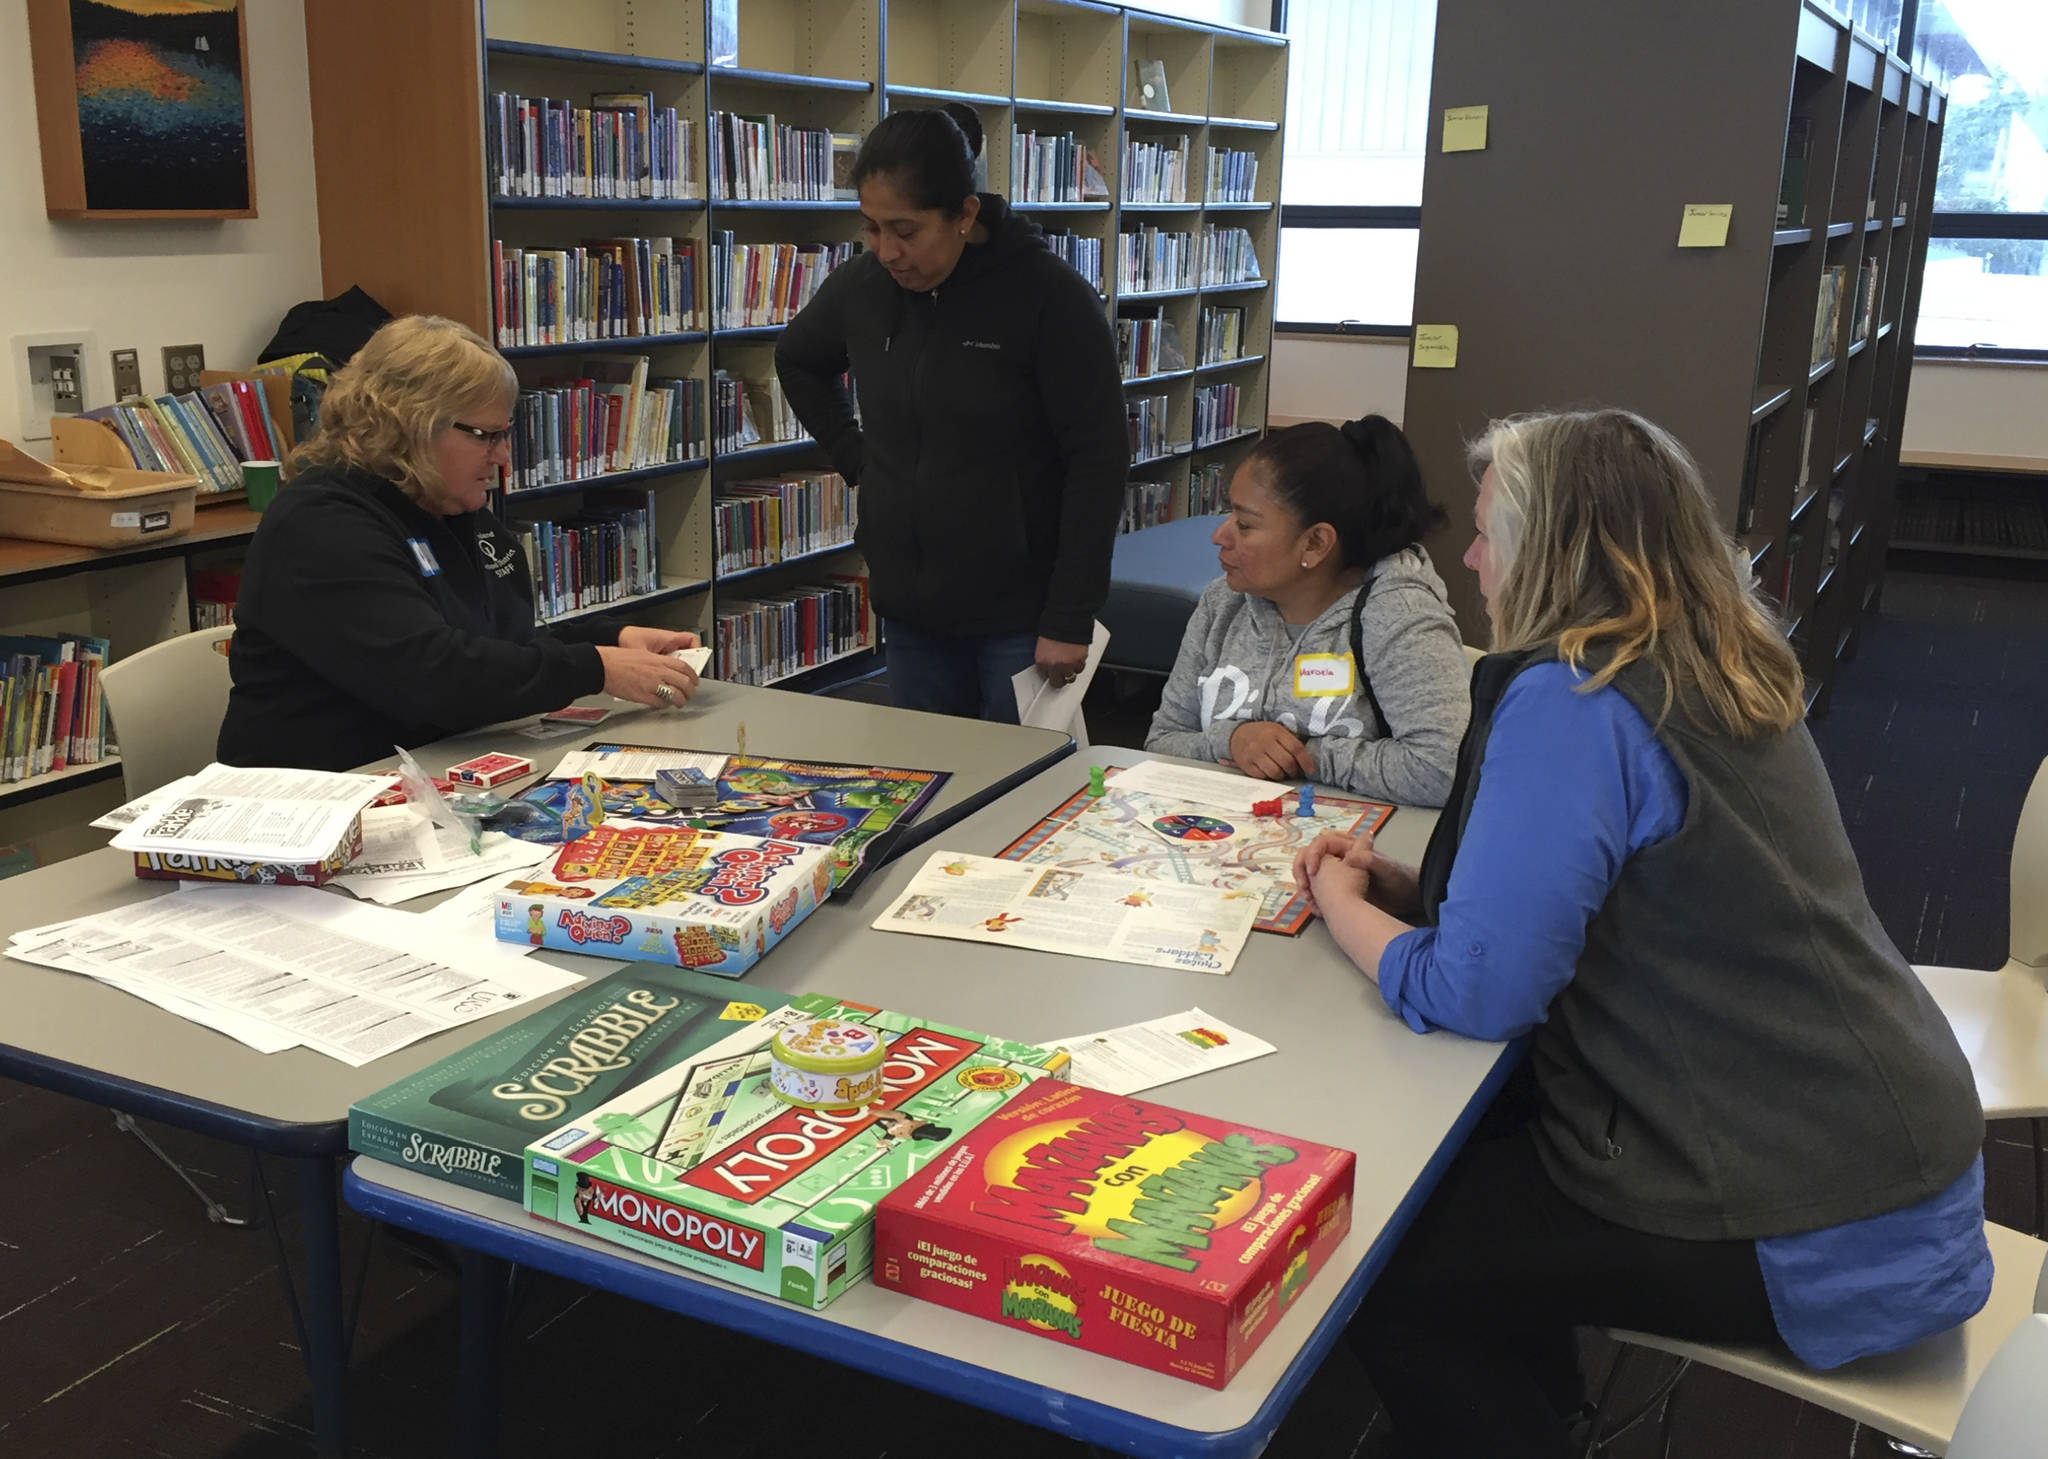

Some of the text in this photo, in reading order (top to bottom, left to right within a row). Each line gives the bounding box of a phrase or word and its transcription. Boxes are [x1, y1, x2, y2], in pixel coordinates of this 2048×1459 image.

[495, 563, 514, 578] STAFF
[559, 911, 612, 931] Adivina
[1175, 957, 1223, 970] Chutes
[491, 989, 680, 1121] SCRABBLE
[402, 1132, 502, 1178] SCRABBLE
[972, 1104, 1187, 1237] MANZANAS
[1103, 1165, 1150, 1188] con
[594, 1183, 759, 1261] MONOPOLY
[1092, 1132, 1300, 1274] MANZANAS
[907, 1250, 988, 1282] comparaciones
[931, 1243, 963, 1263] juego
[964, 1254, 979, 1266] de
[920, 1266, 974, 1291] graciosas!
[1034, 1287, 1050, 1300] con
[1001, 1289, 1083, 1340] MANZANAS
[1098, 1284, 1198, 1340] JUEGO DE
[1108, 1305, 1178, 1351] FIESTA
